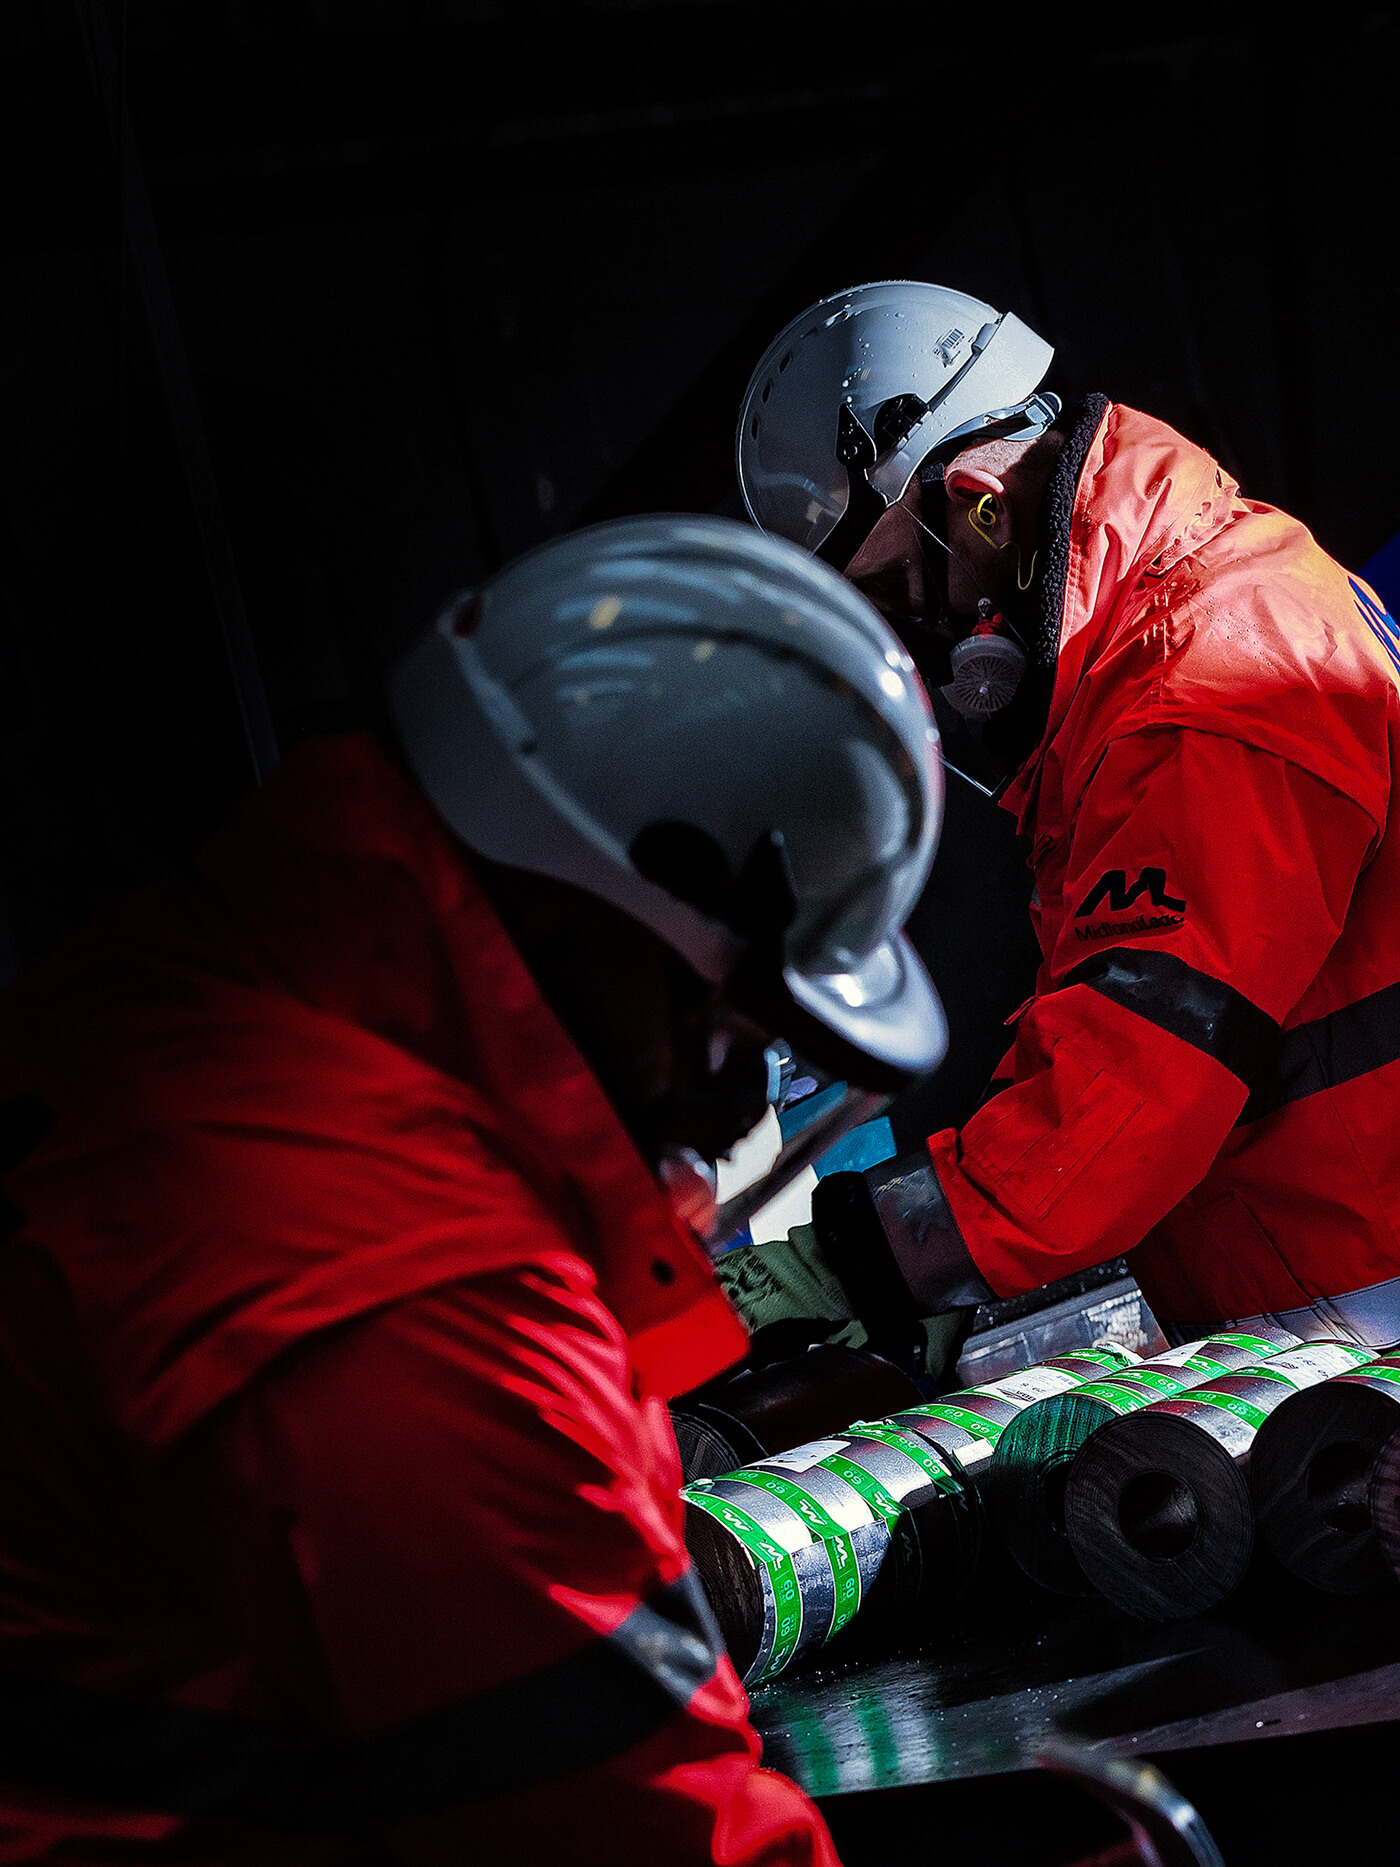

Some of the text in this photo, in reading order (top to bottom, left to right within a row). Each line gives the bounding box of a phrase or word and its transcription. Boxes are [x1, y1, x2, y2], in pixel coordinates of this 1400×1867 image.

[922, 1458, 941, 1475] 60
[843, 1469, 862, 1485] 60
[765, 1481, 786, 1495] 60
[783, 1578, 796, 1601] 60
[845, 1577, 856, 1599] 60
[780, 1616, 792, 1637] 60
